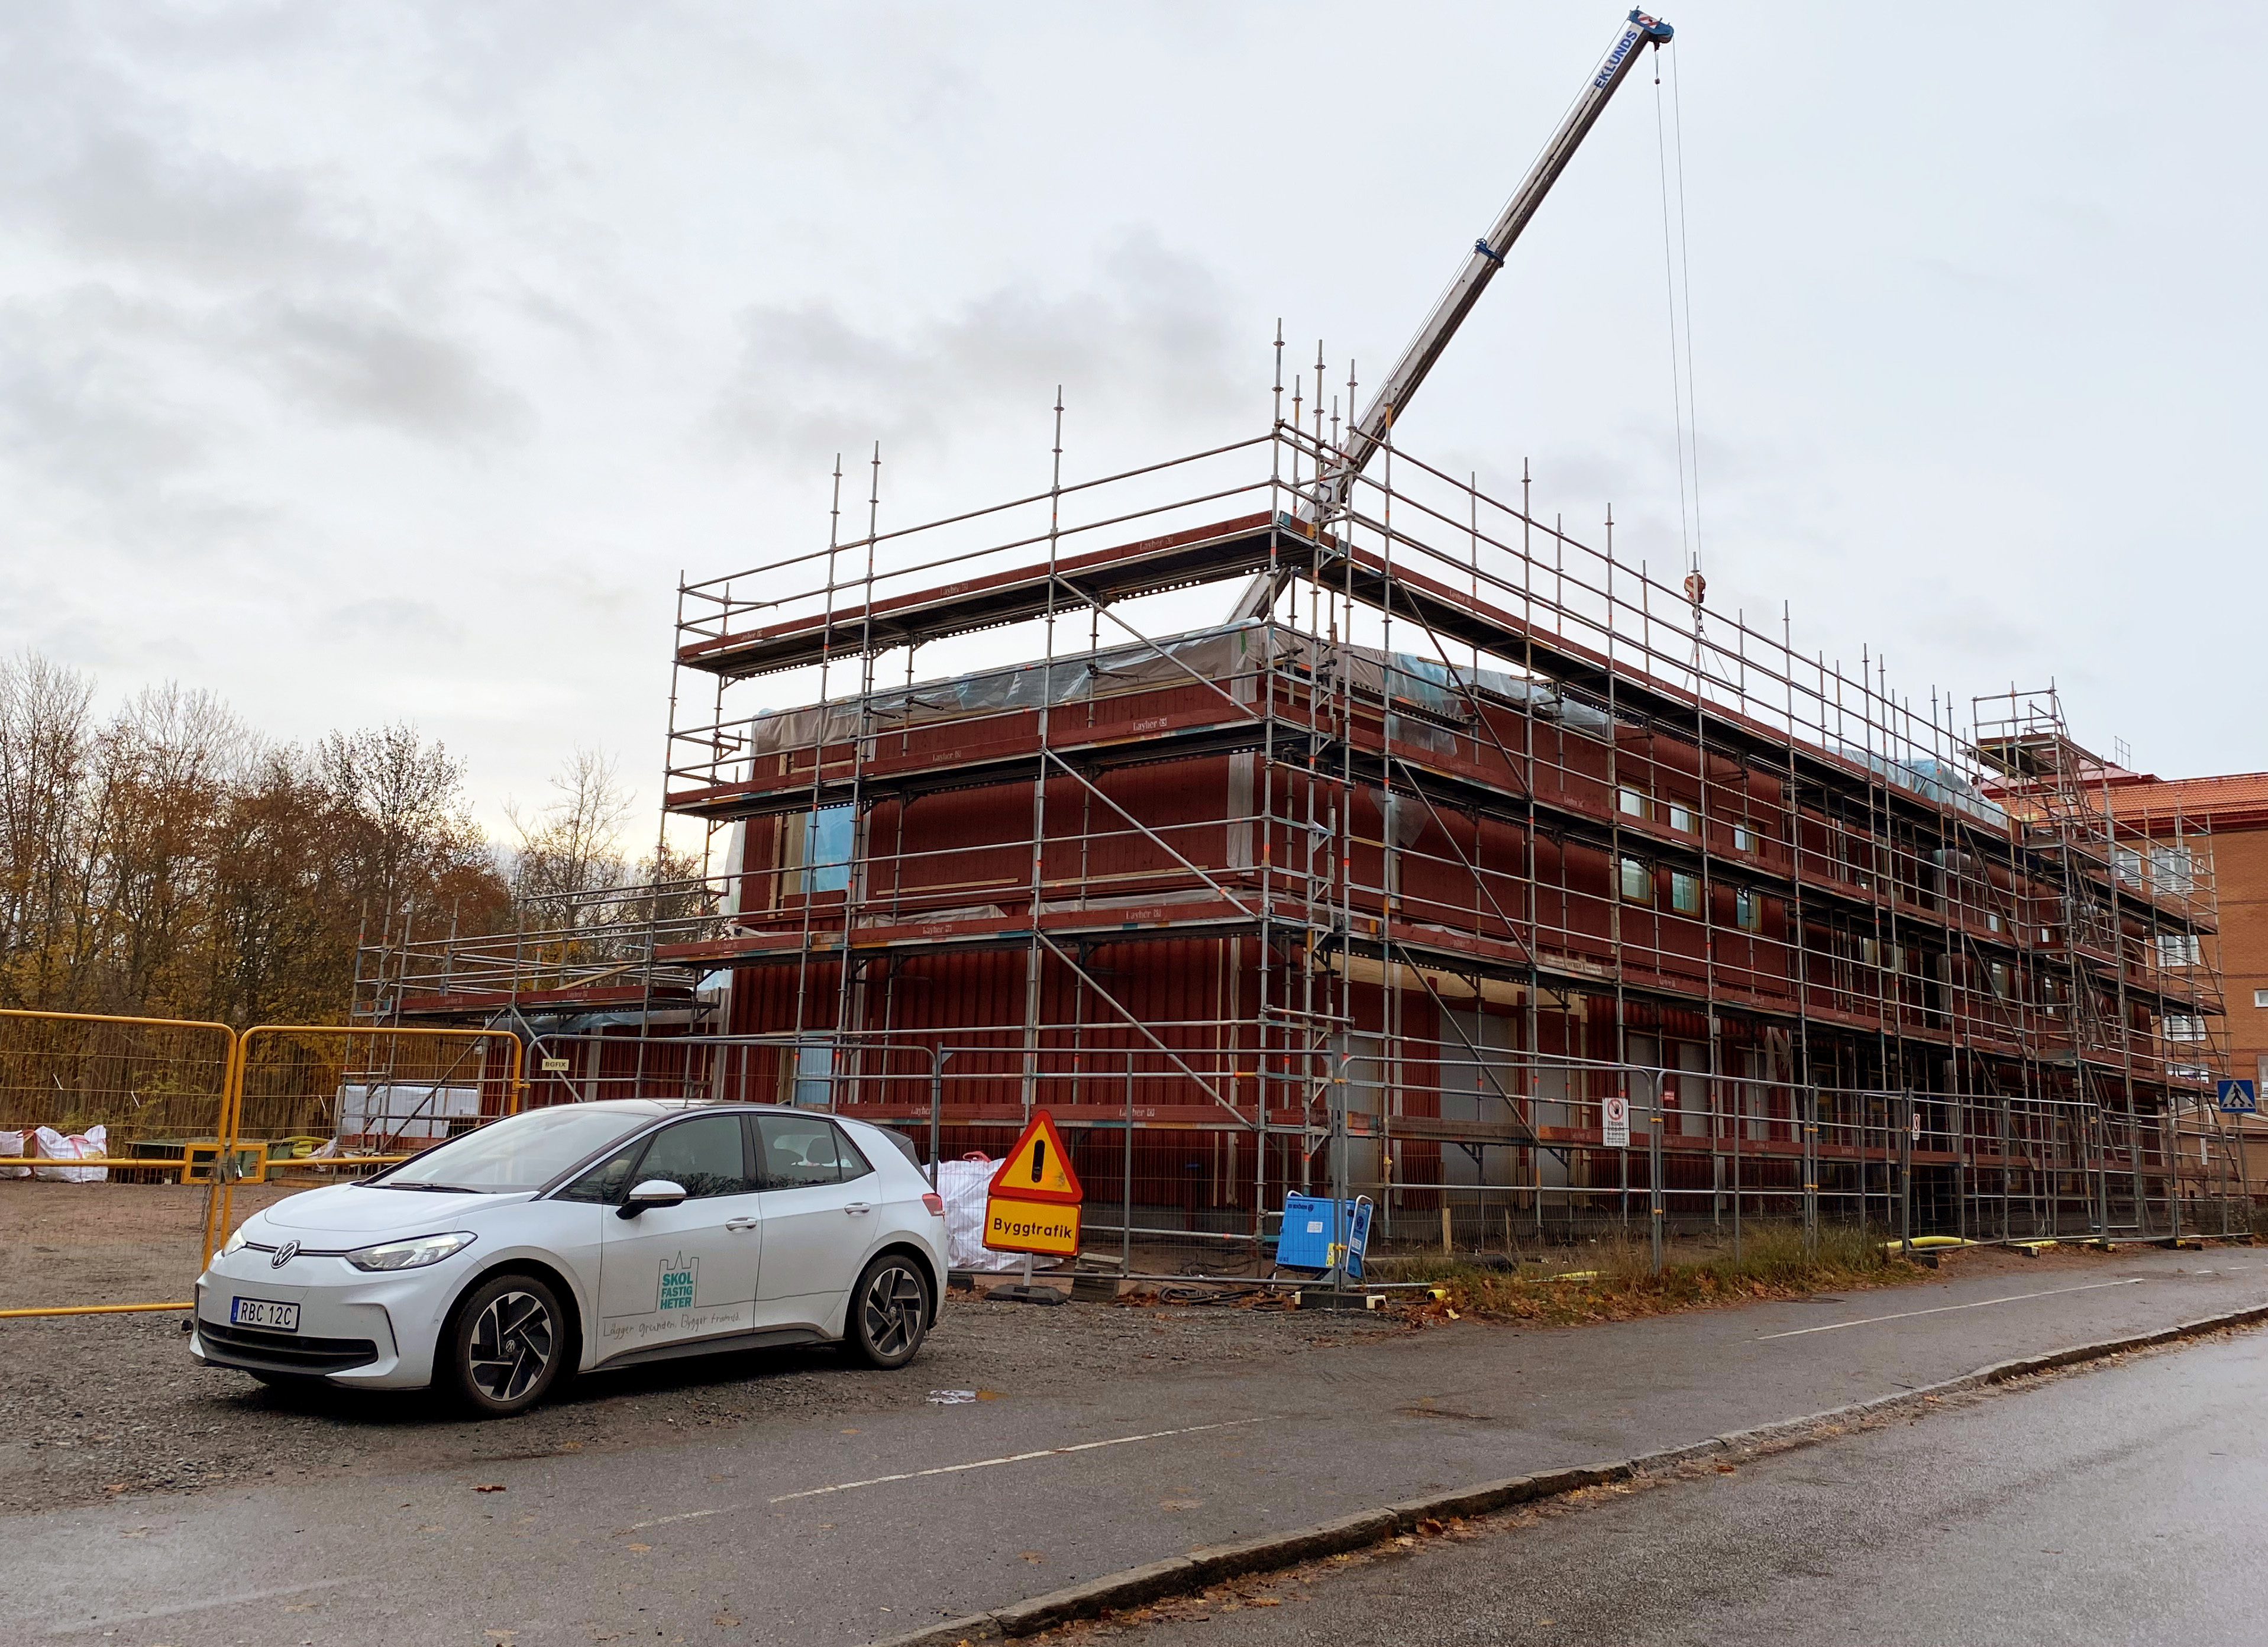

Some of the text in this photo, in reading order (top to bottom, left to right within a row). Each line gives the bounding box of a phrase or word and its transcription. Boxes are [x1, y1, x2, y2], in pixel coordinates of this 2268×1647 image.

[1594, 30, 1637, 89] EKLUNDS
[1133, 720, 1157, 731] Layher
[1126, 910, 1151, 919] Layher
[922, 925, 943, 936] Layher
[1119, 1107, 1145, 1117] Laher
[993, 1218, 1072, 1239] Byggtrafik
[662, 1272, 693, 1286] SKOL
[661, 1286, 693, 1298] FASTIG
[660, 1297, 692, 1309] HETER
[241, 1302, 292, 1325] RBC 12C
[603, 1323, 634, 1339] Lägger
